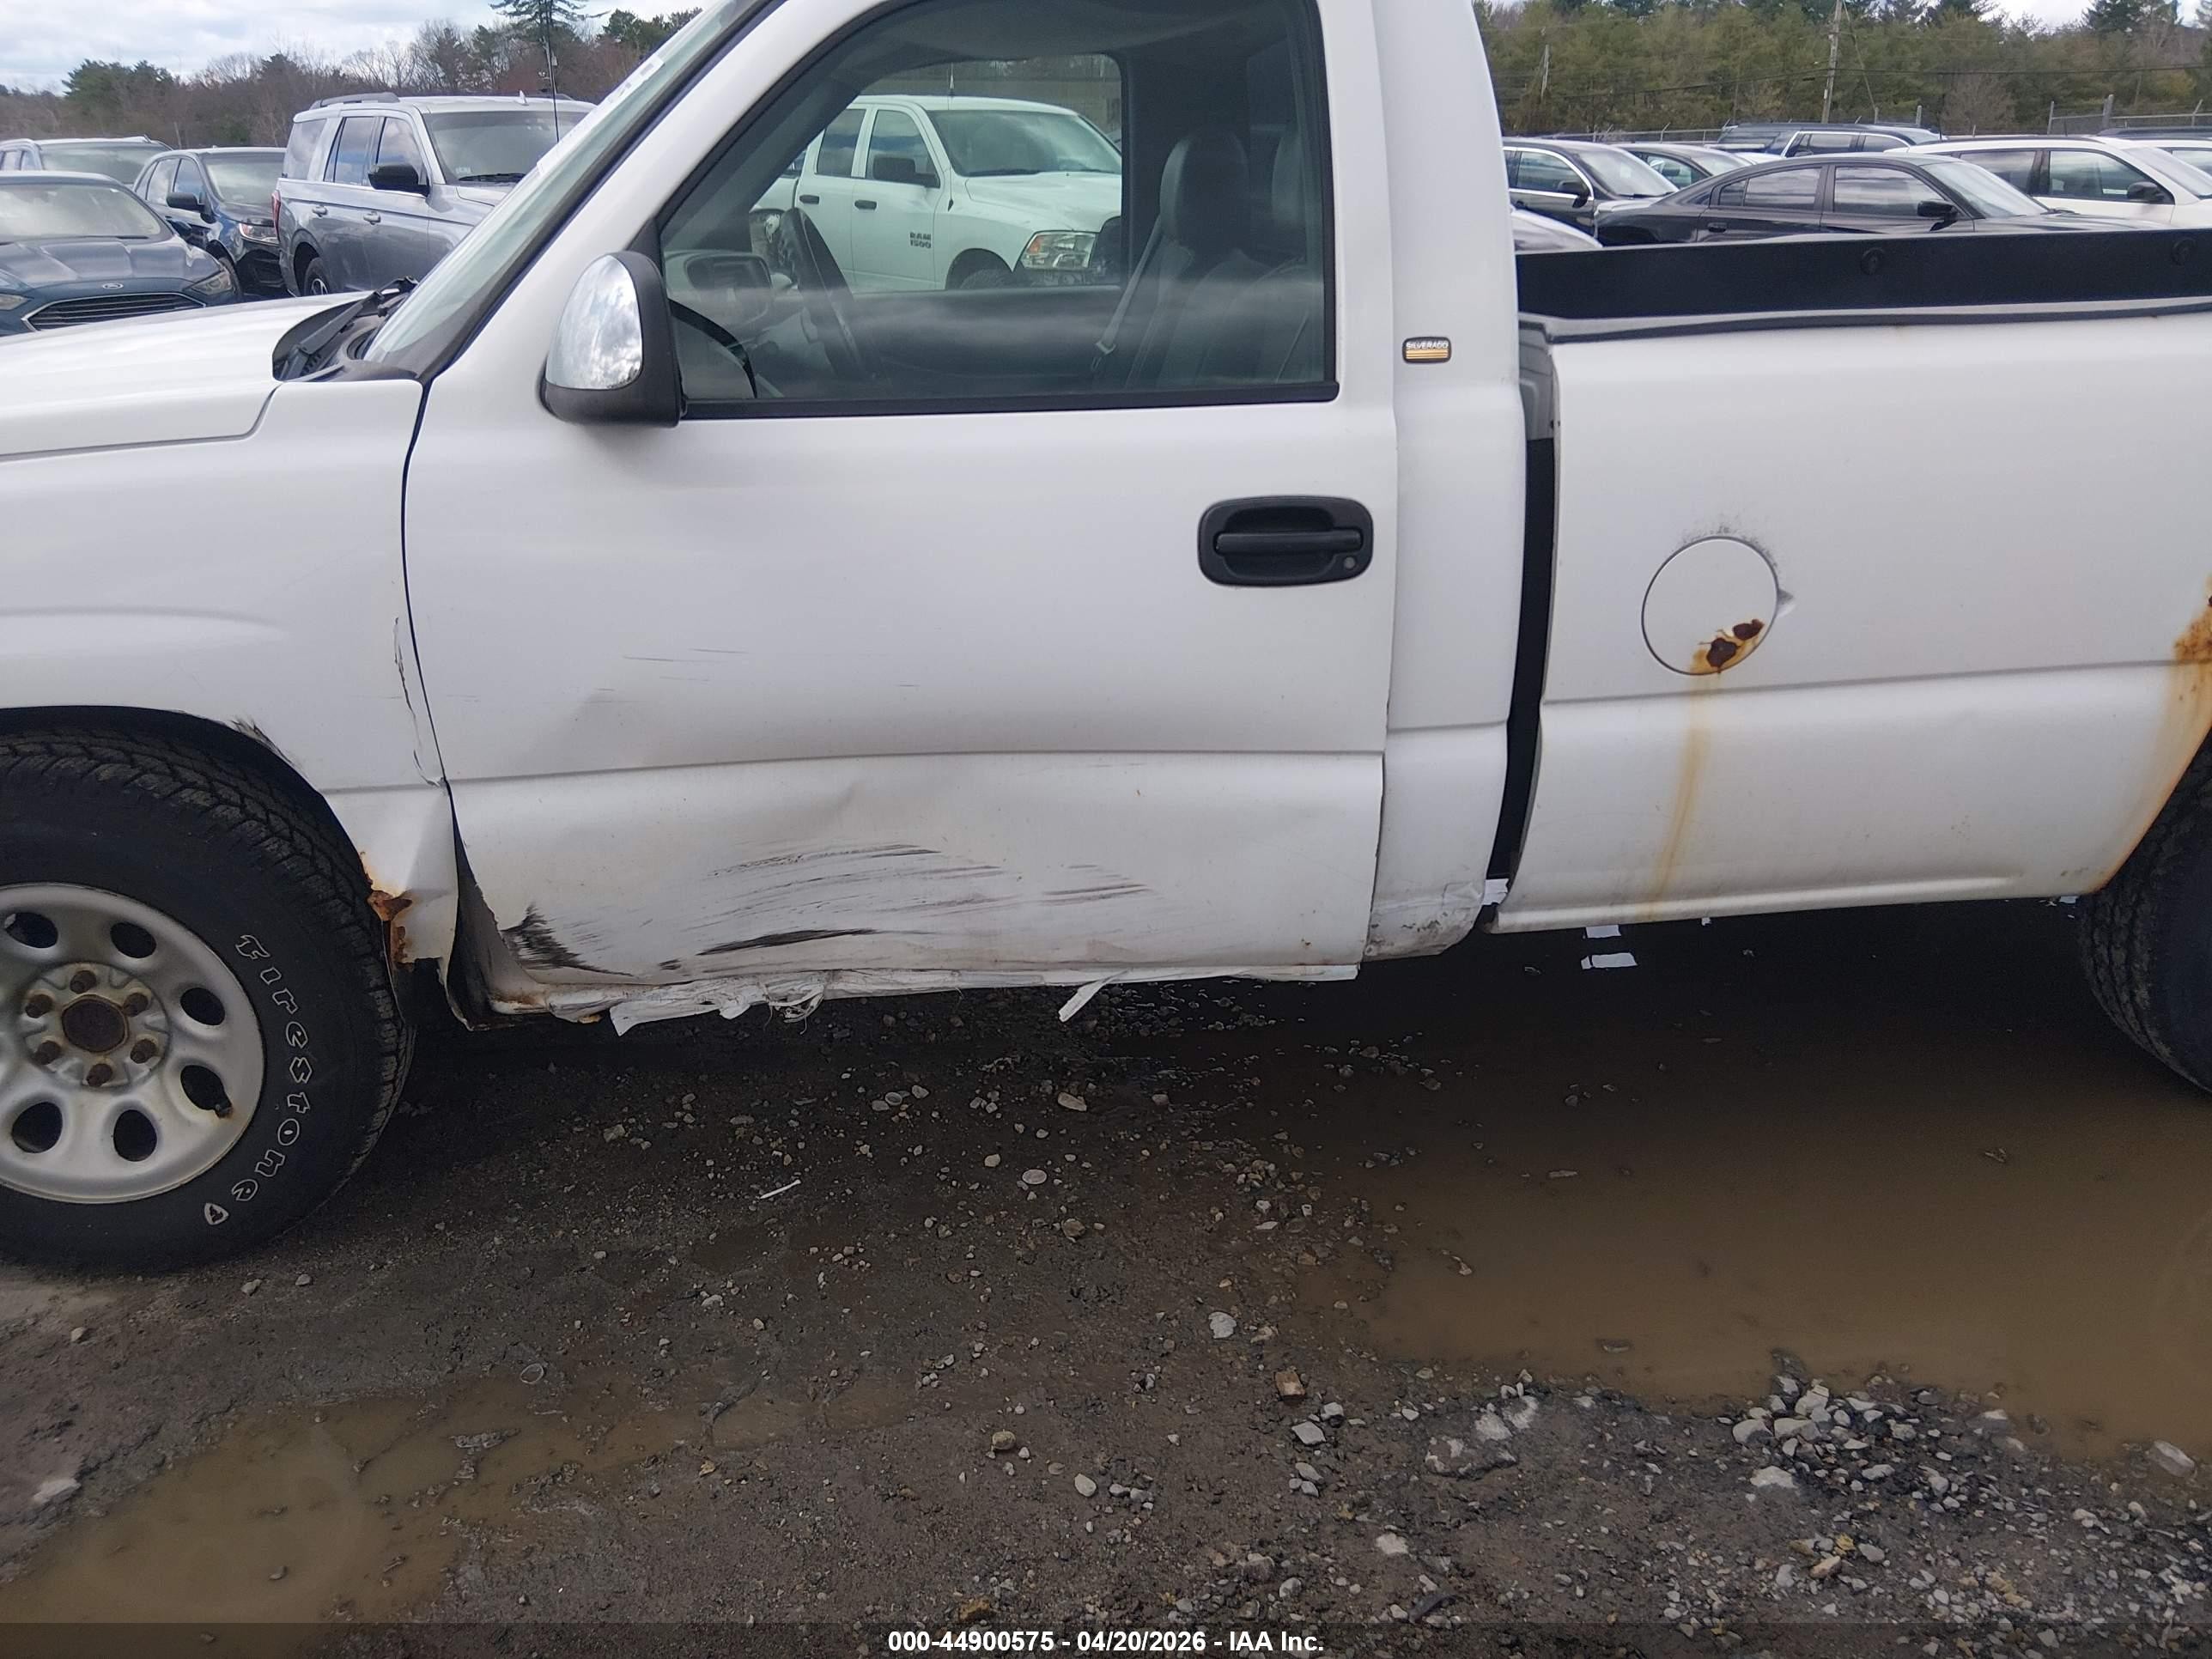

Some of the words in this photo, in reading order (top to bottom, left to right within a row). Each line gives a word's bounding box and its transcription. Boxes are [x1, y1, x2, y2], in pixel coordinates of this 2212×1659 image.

[909, 232, 932, 240] RAM
[909, 240, 932, 248] 1500
[1406, 340, 1449, 349] SILVERADO
[231, 934, 313, 1201] Firestone
